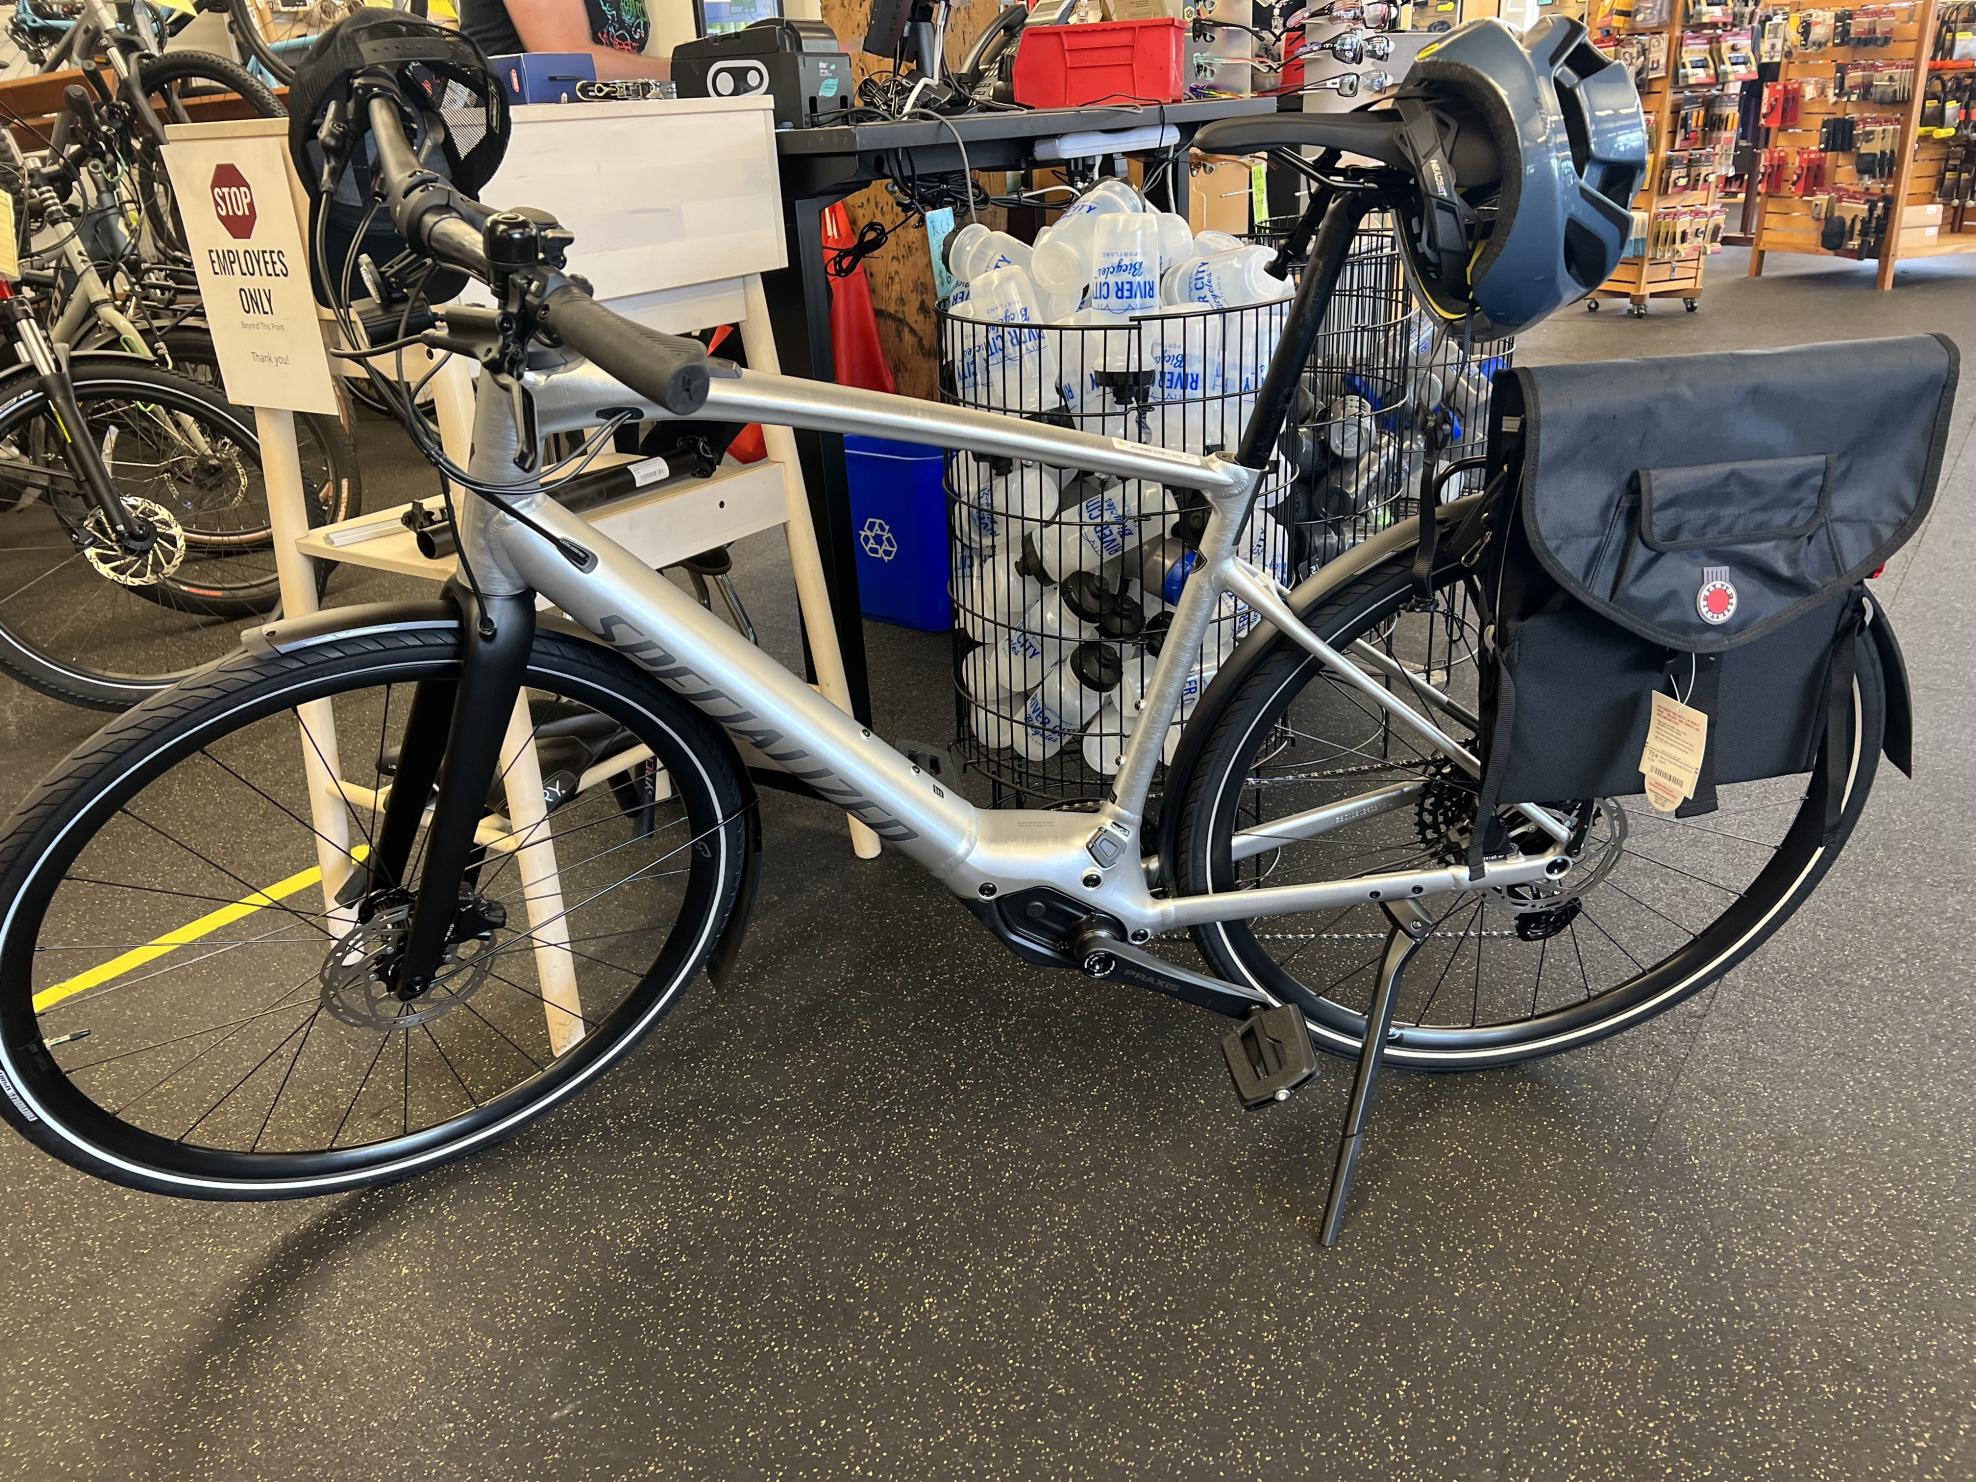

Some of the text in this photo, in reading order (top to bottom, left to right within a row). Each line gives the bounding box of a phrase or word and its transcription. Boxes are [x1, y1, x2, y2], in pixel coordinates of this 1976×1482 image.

[1430, 160, 1448, 197] HEADSET
[213, 187, 251, 217] STOP
[208, 249, 289, 278] EMPLOYEES
[1098, 258, 1143, 280] Bicycles
[1194, 260, 1210, 291] CITY
[239, 287, 275, 316] ONLY
[1093, 281, 1155, 299] RIVER CIT
[241, 321, 285, 331] Beyond This Point
[251, 352, 290, 366] Thank you!
[1158, 371, 1200, 391] RIVER
[1093, 525, 1122, 556] RIVER
[600, 615, 919, 842] SPECIALIZED
[1123, 969, 1180, 992] PRAXIS
